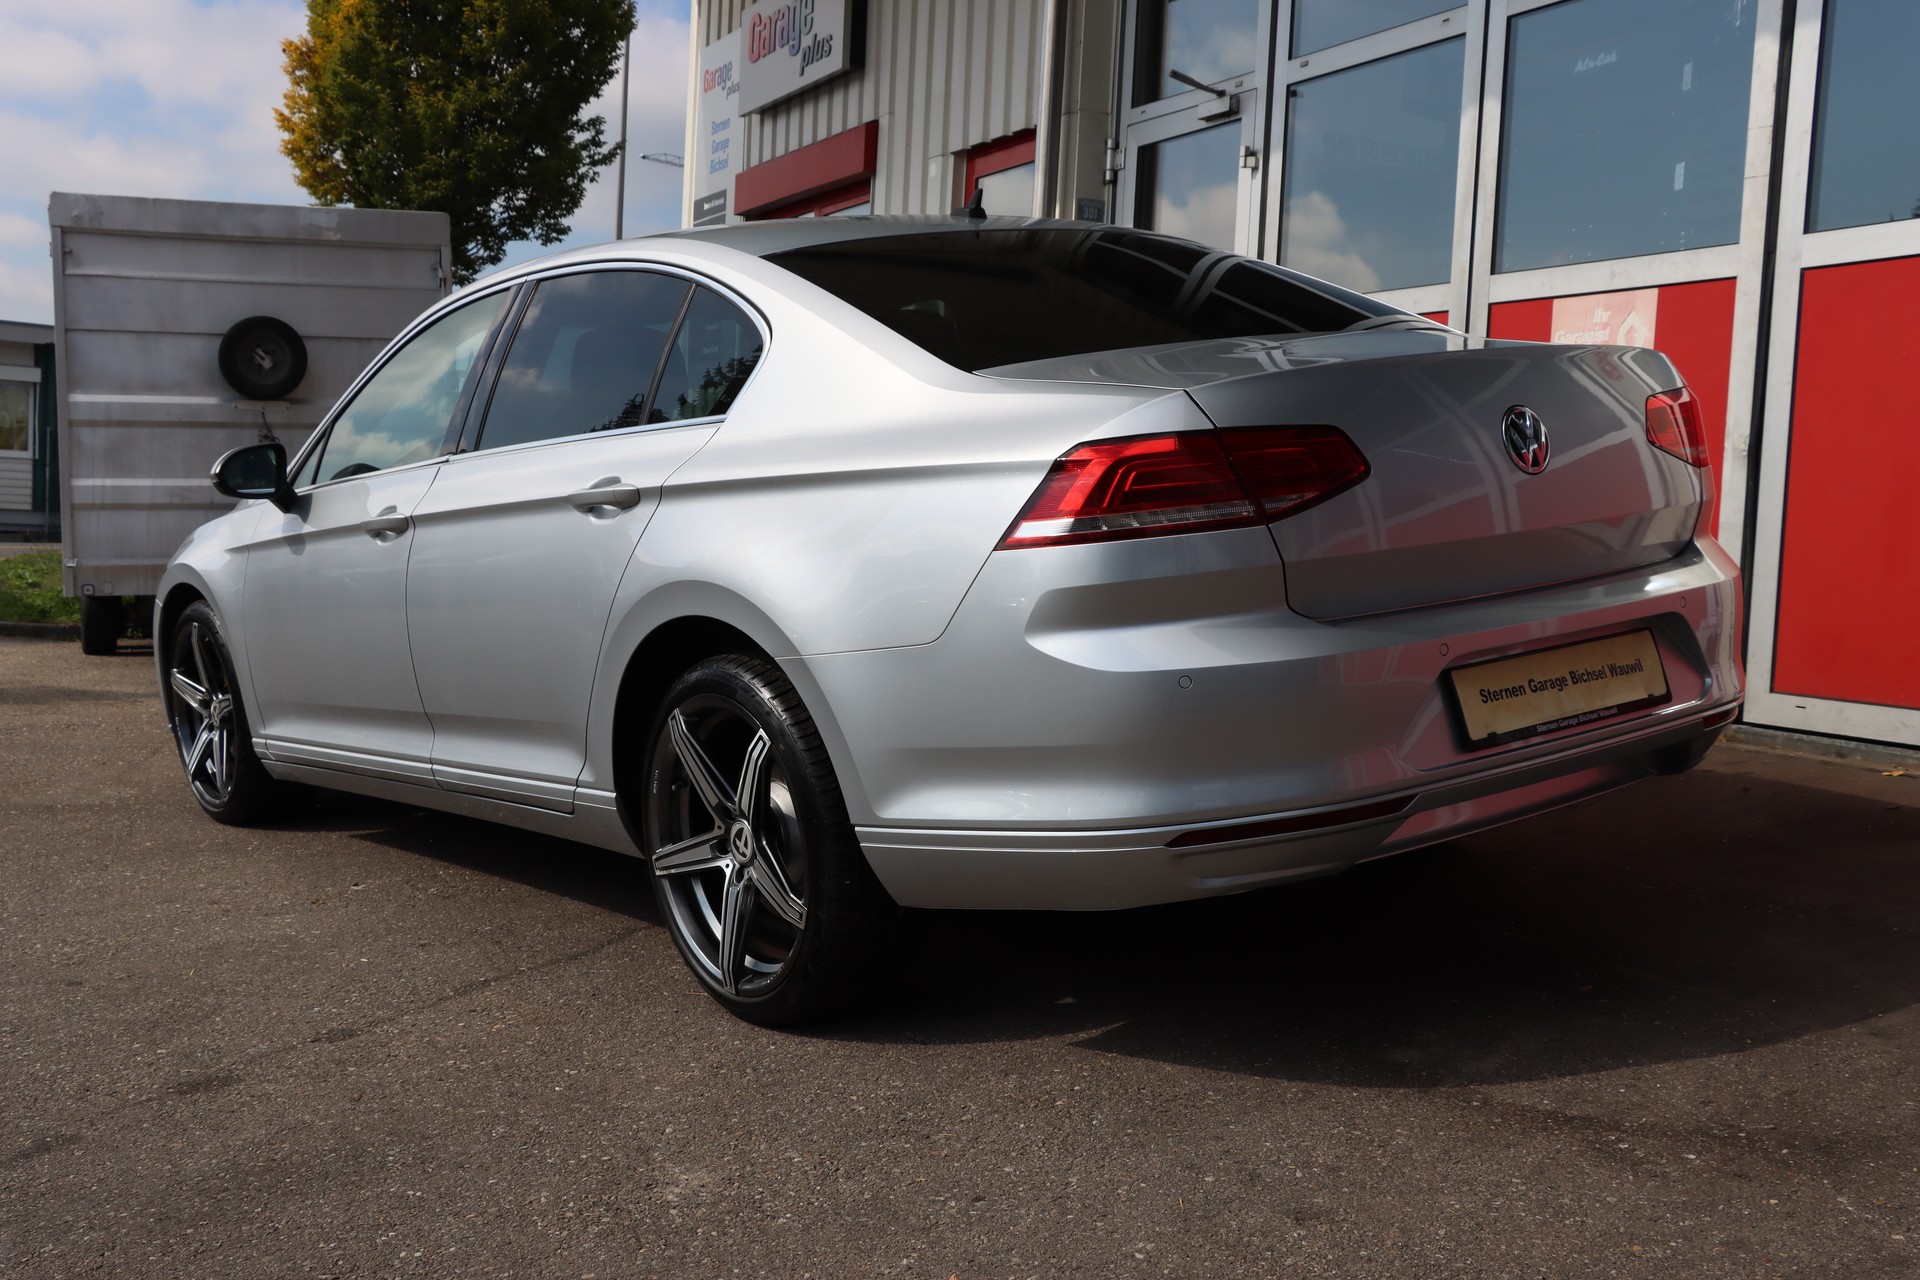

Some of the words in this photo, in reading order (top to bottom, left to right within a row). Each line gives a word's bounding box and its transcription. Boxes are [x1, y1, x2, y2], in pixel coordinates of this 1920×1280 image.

[748, 0, 814, 64] Garage
[799, 33, 833, 77] plus
[703, 61, 733, 94] Garage
[726, 80, 740, 101] plus
[711, 138, 730, 155] Garage
[1083, 206, 1098, 220] 301
[1593, 307, 1613, 323] Ihr
[1479, 684, 1527, 704] Sternen
[1528, 676, 1569, 692] Garage
[1569, 665, 1607, 685] Bichsel
[1607, 658, 1644, 678] Wauwil
[1536, 720, 1559, 732] Sternen
[1558, 716, 1579, 728] Garage
[1579, 711, 1599, 722] Bichsel
